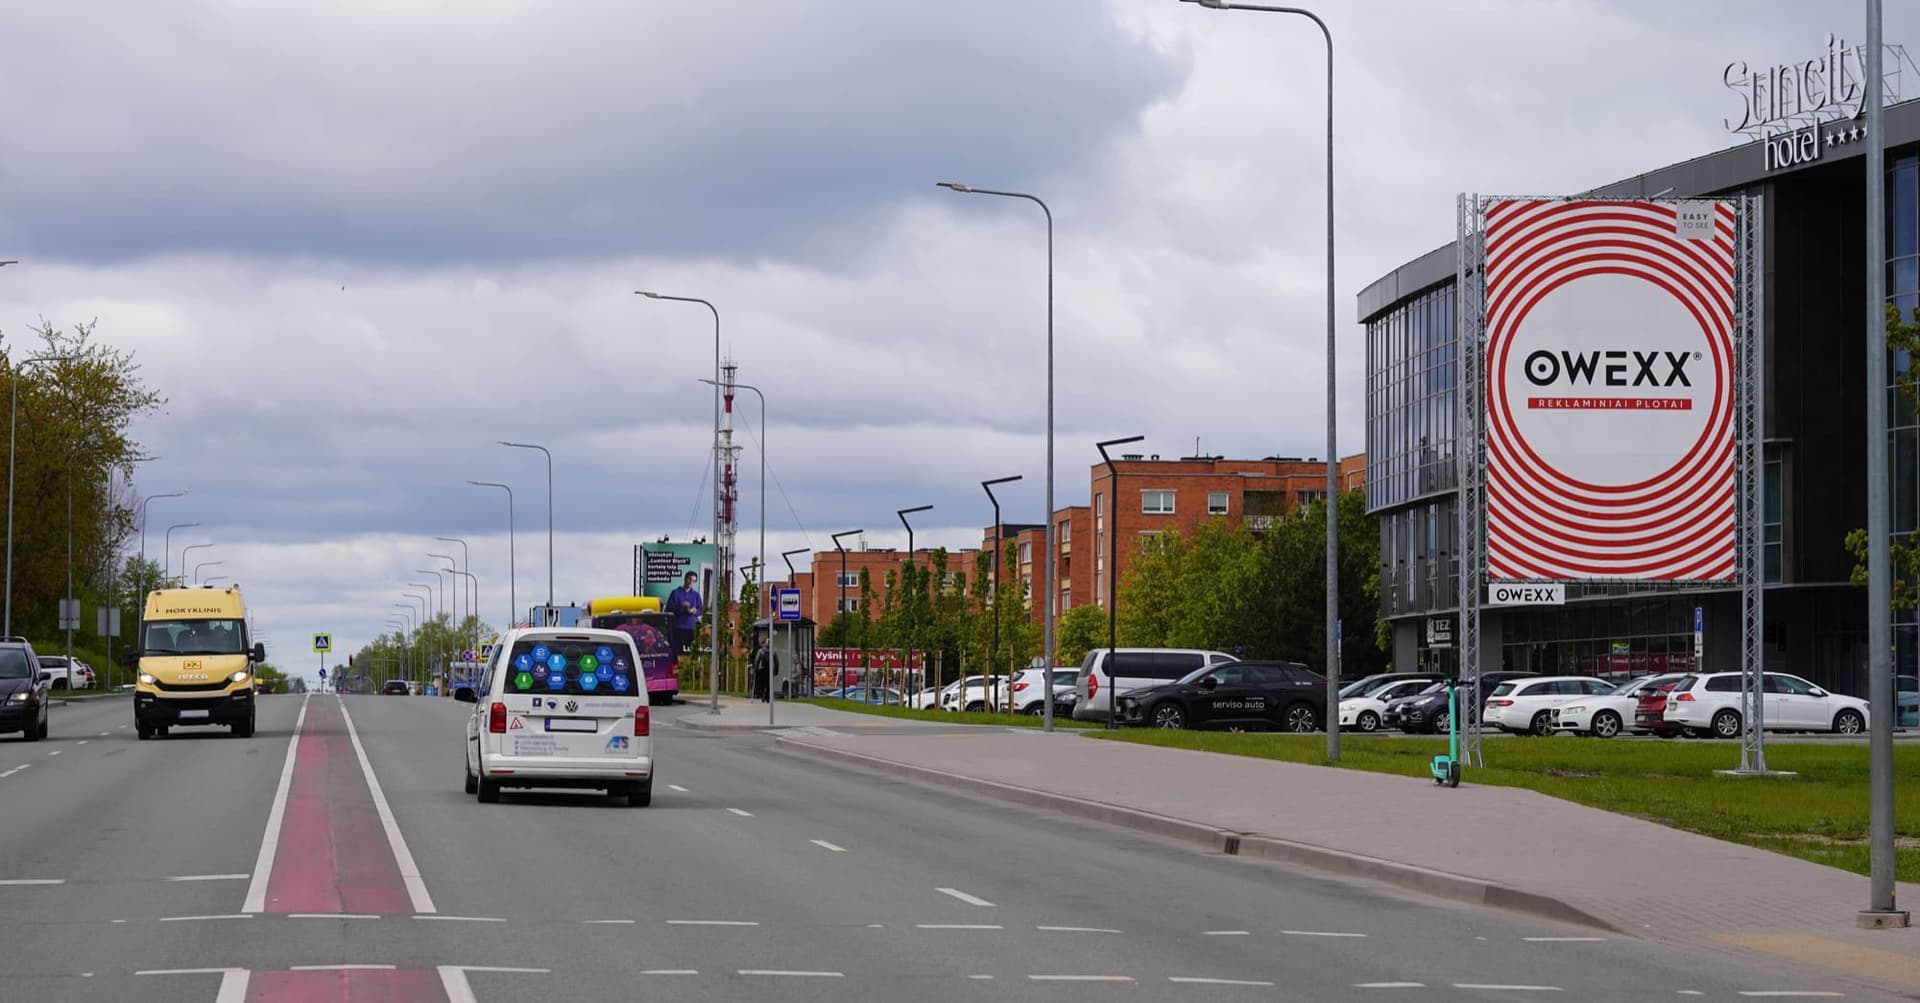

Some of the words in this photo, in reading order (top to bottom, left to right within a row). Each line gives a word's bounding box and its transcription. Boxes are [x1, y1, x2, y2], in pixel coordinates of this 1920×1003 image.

[1723, 32, 1868, 133] Suncity
[1764, 117, 1820, 171] hotel
[1538, 399, 1628, 408] REKLAMINIAI
[1636, 399, 1684, 409] PLOTAI
[1435, 619, 1450, 631] TEZ
[1212, 700, 1243, 709] serviso
[1244, 700, 1265, 709] auto
